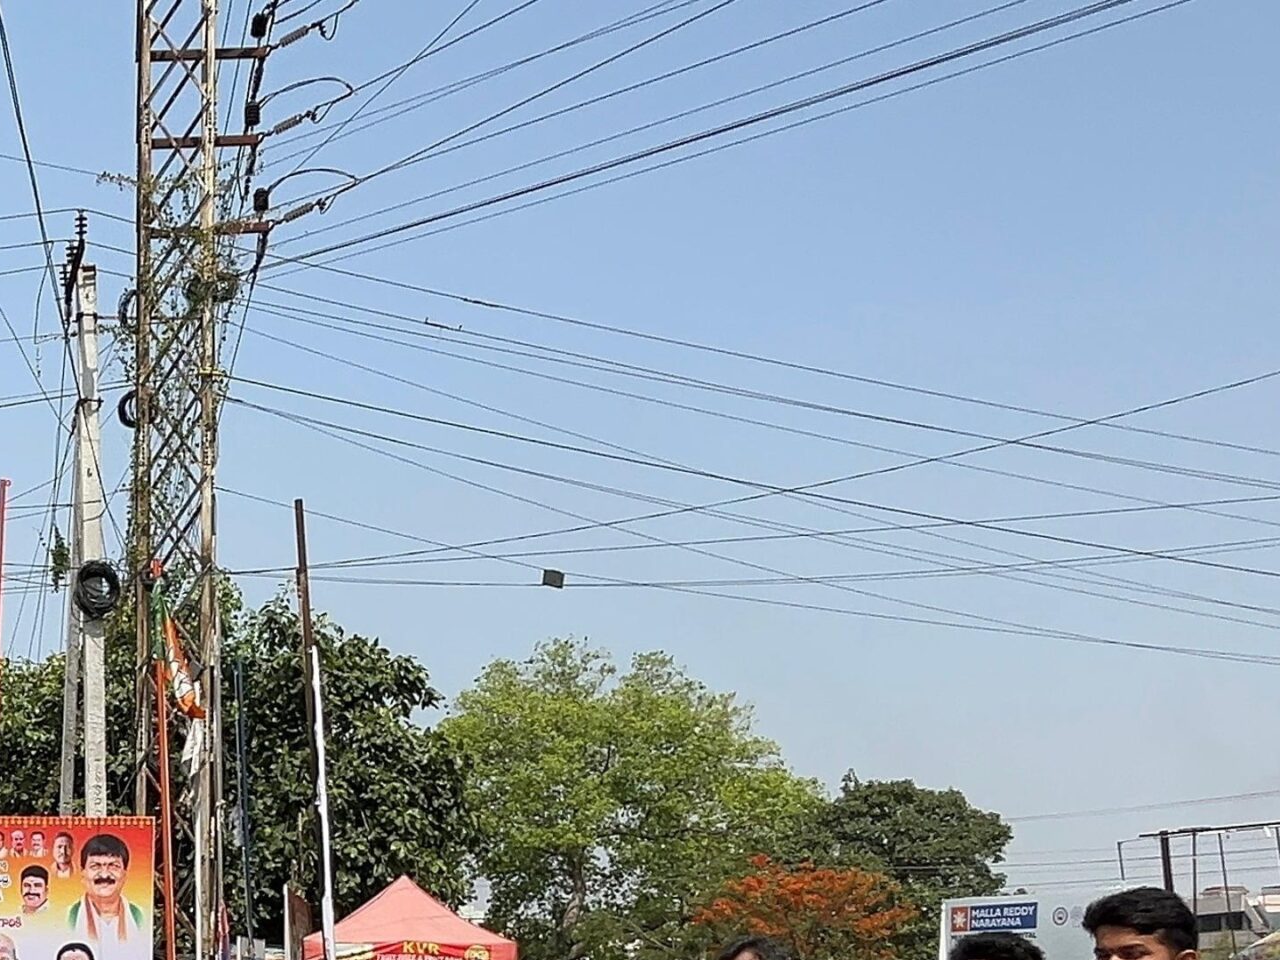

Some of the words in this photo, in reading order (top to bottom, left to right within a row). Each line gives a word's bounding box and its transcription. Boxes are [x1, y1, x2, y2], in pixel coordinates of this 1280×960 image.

[972, 908, 1001, 918] MALLA
[1003, 905, 1035, 916] REDDY
[971, 917, 1022, 928] NARAYANA
[402, 942, 439, 955] KVR
